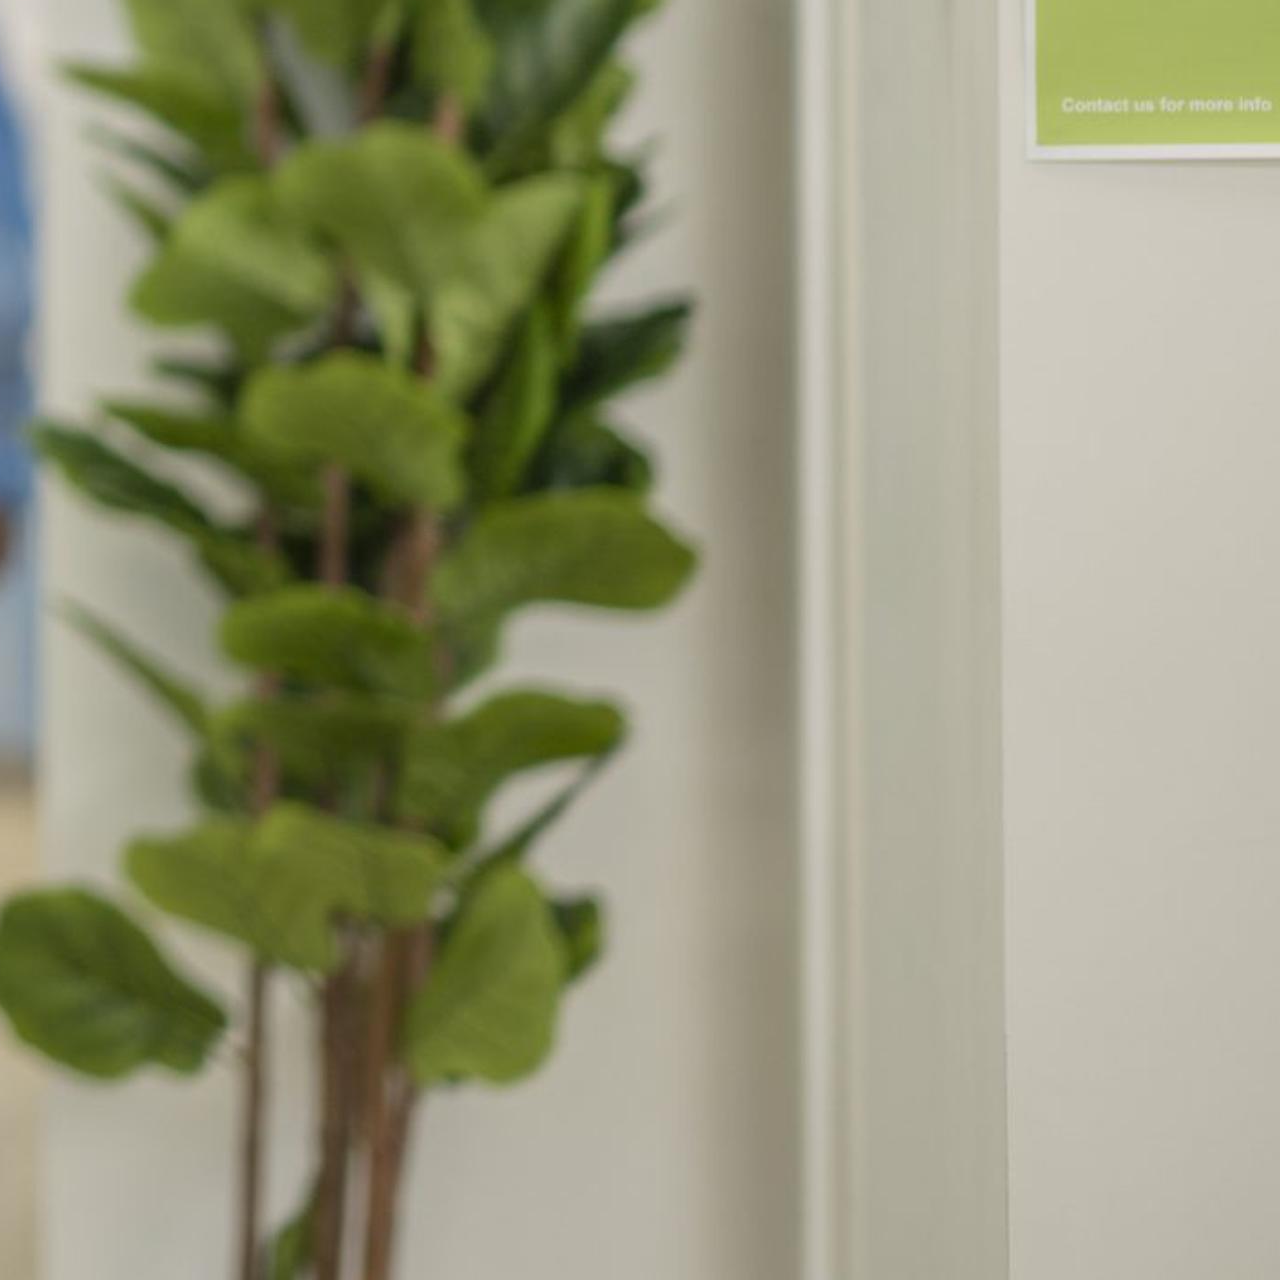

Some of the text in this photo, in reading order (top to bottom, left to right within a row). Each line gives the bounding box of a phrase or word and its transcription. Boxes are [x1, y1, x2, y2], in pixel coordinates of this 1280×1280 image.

[1061, 97, 1129, 112] Contact
[1135, 100, 1154, 112] us
[1160, 97, 1185, 112] for
[1190, 99, 1233, 112] more
